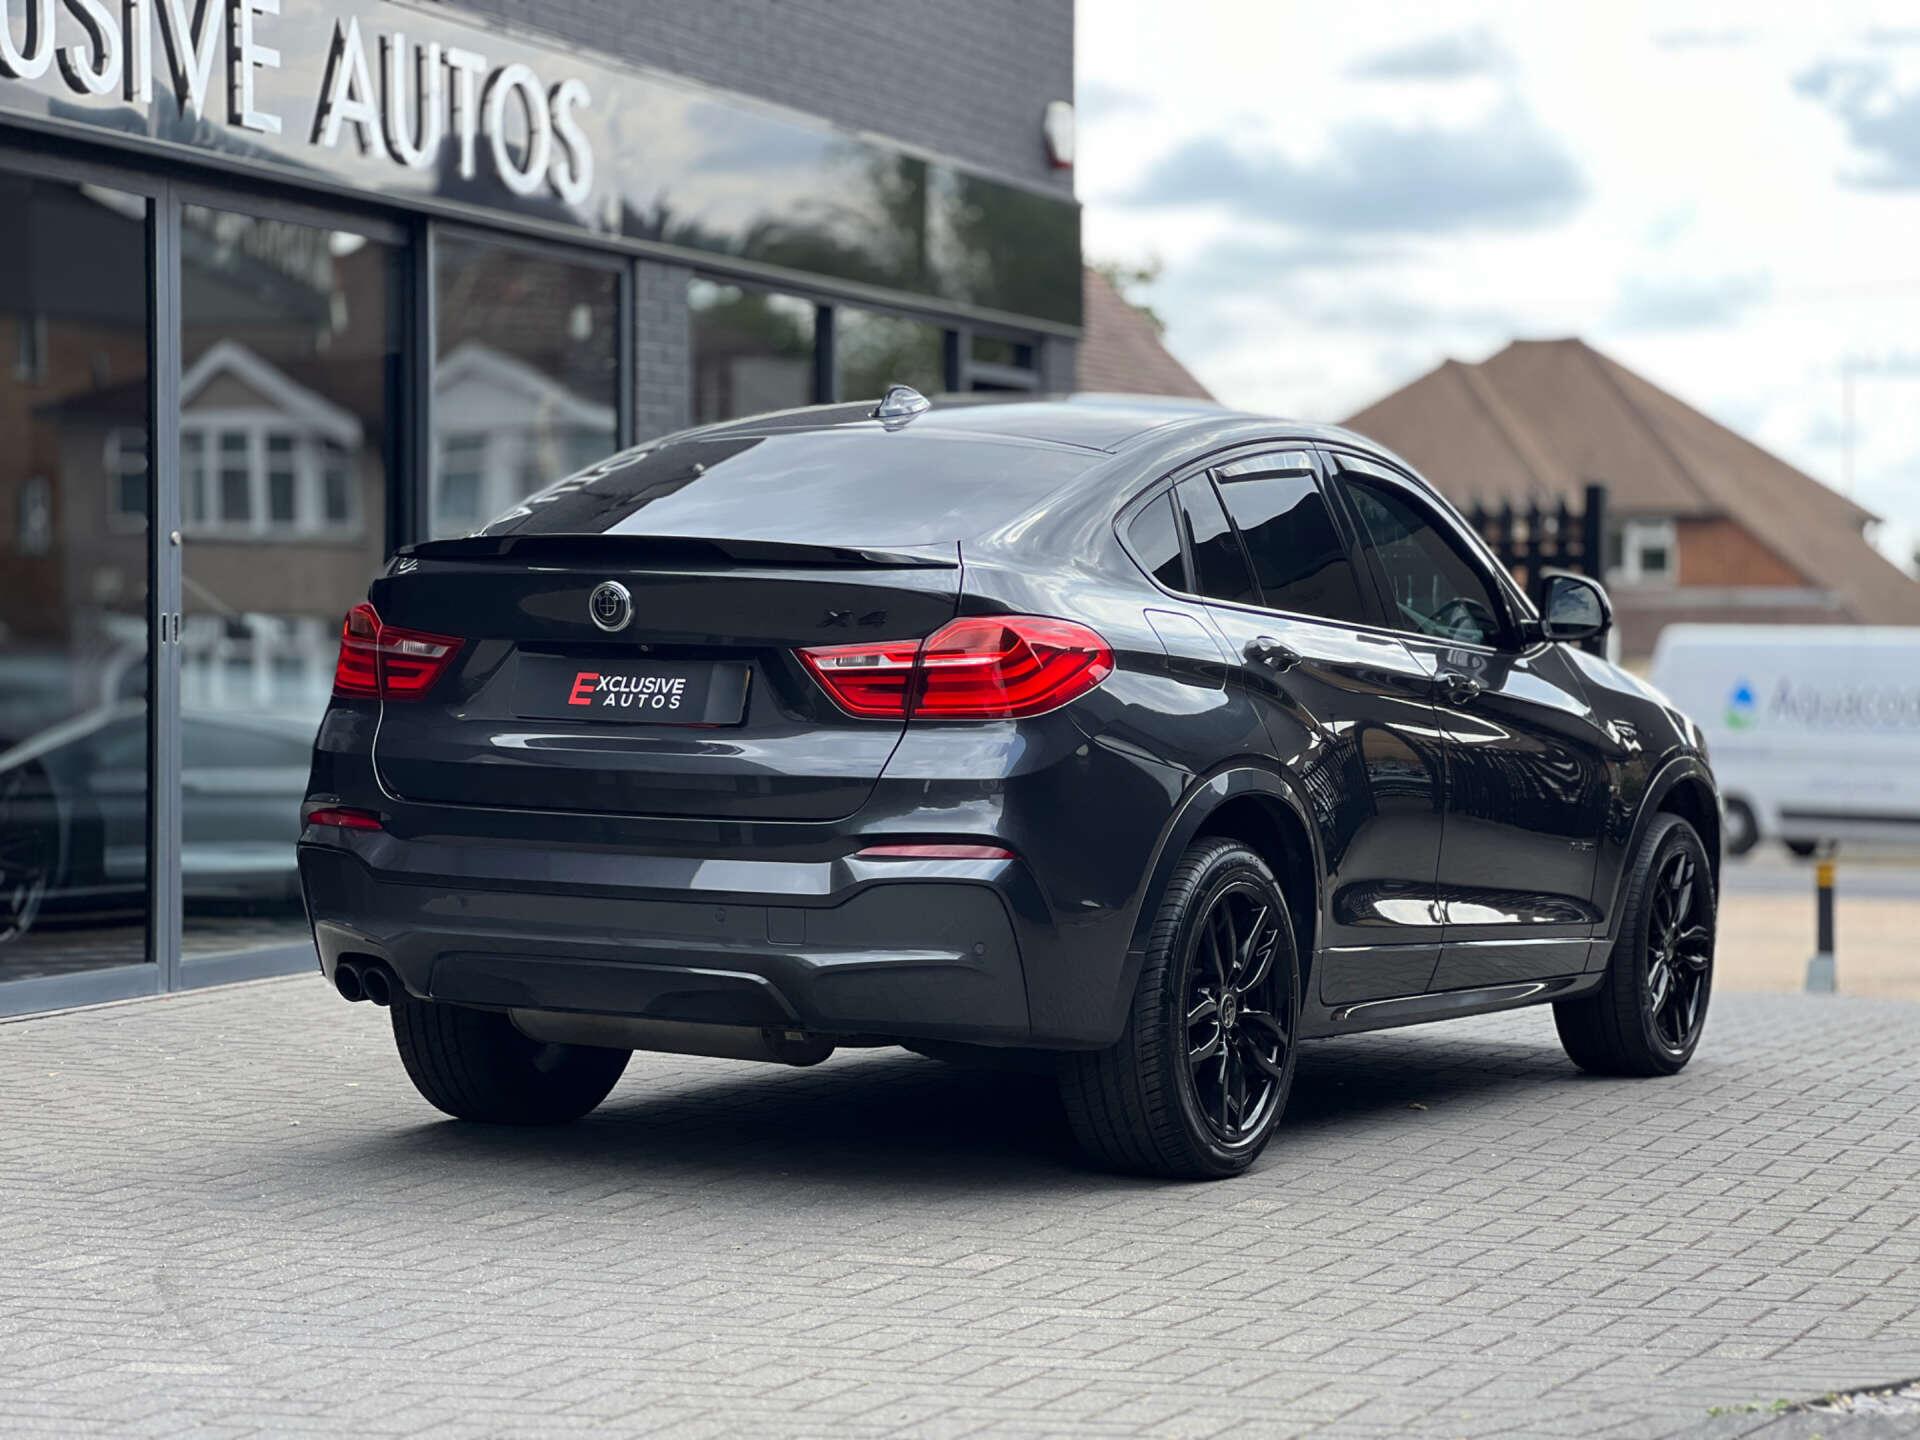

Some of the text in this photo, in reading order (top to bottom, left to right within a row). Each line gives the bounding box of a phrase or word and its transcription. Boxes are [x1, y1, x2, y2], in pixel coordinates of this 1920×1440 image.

[322, 15, 594, 205] AUTOS
[568, 671, 686, 705] EXCLUSIVE
[602, 692, 681, 709] AUTOS
